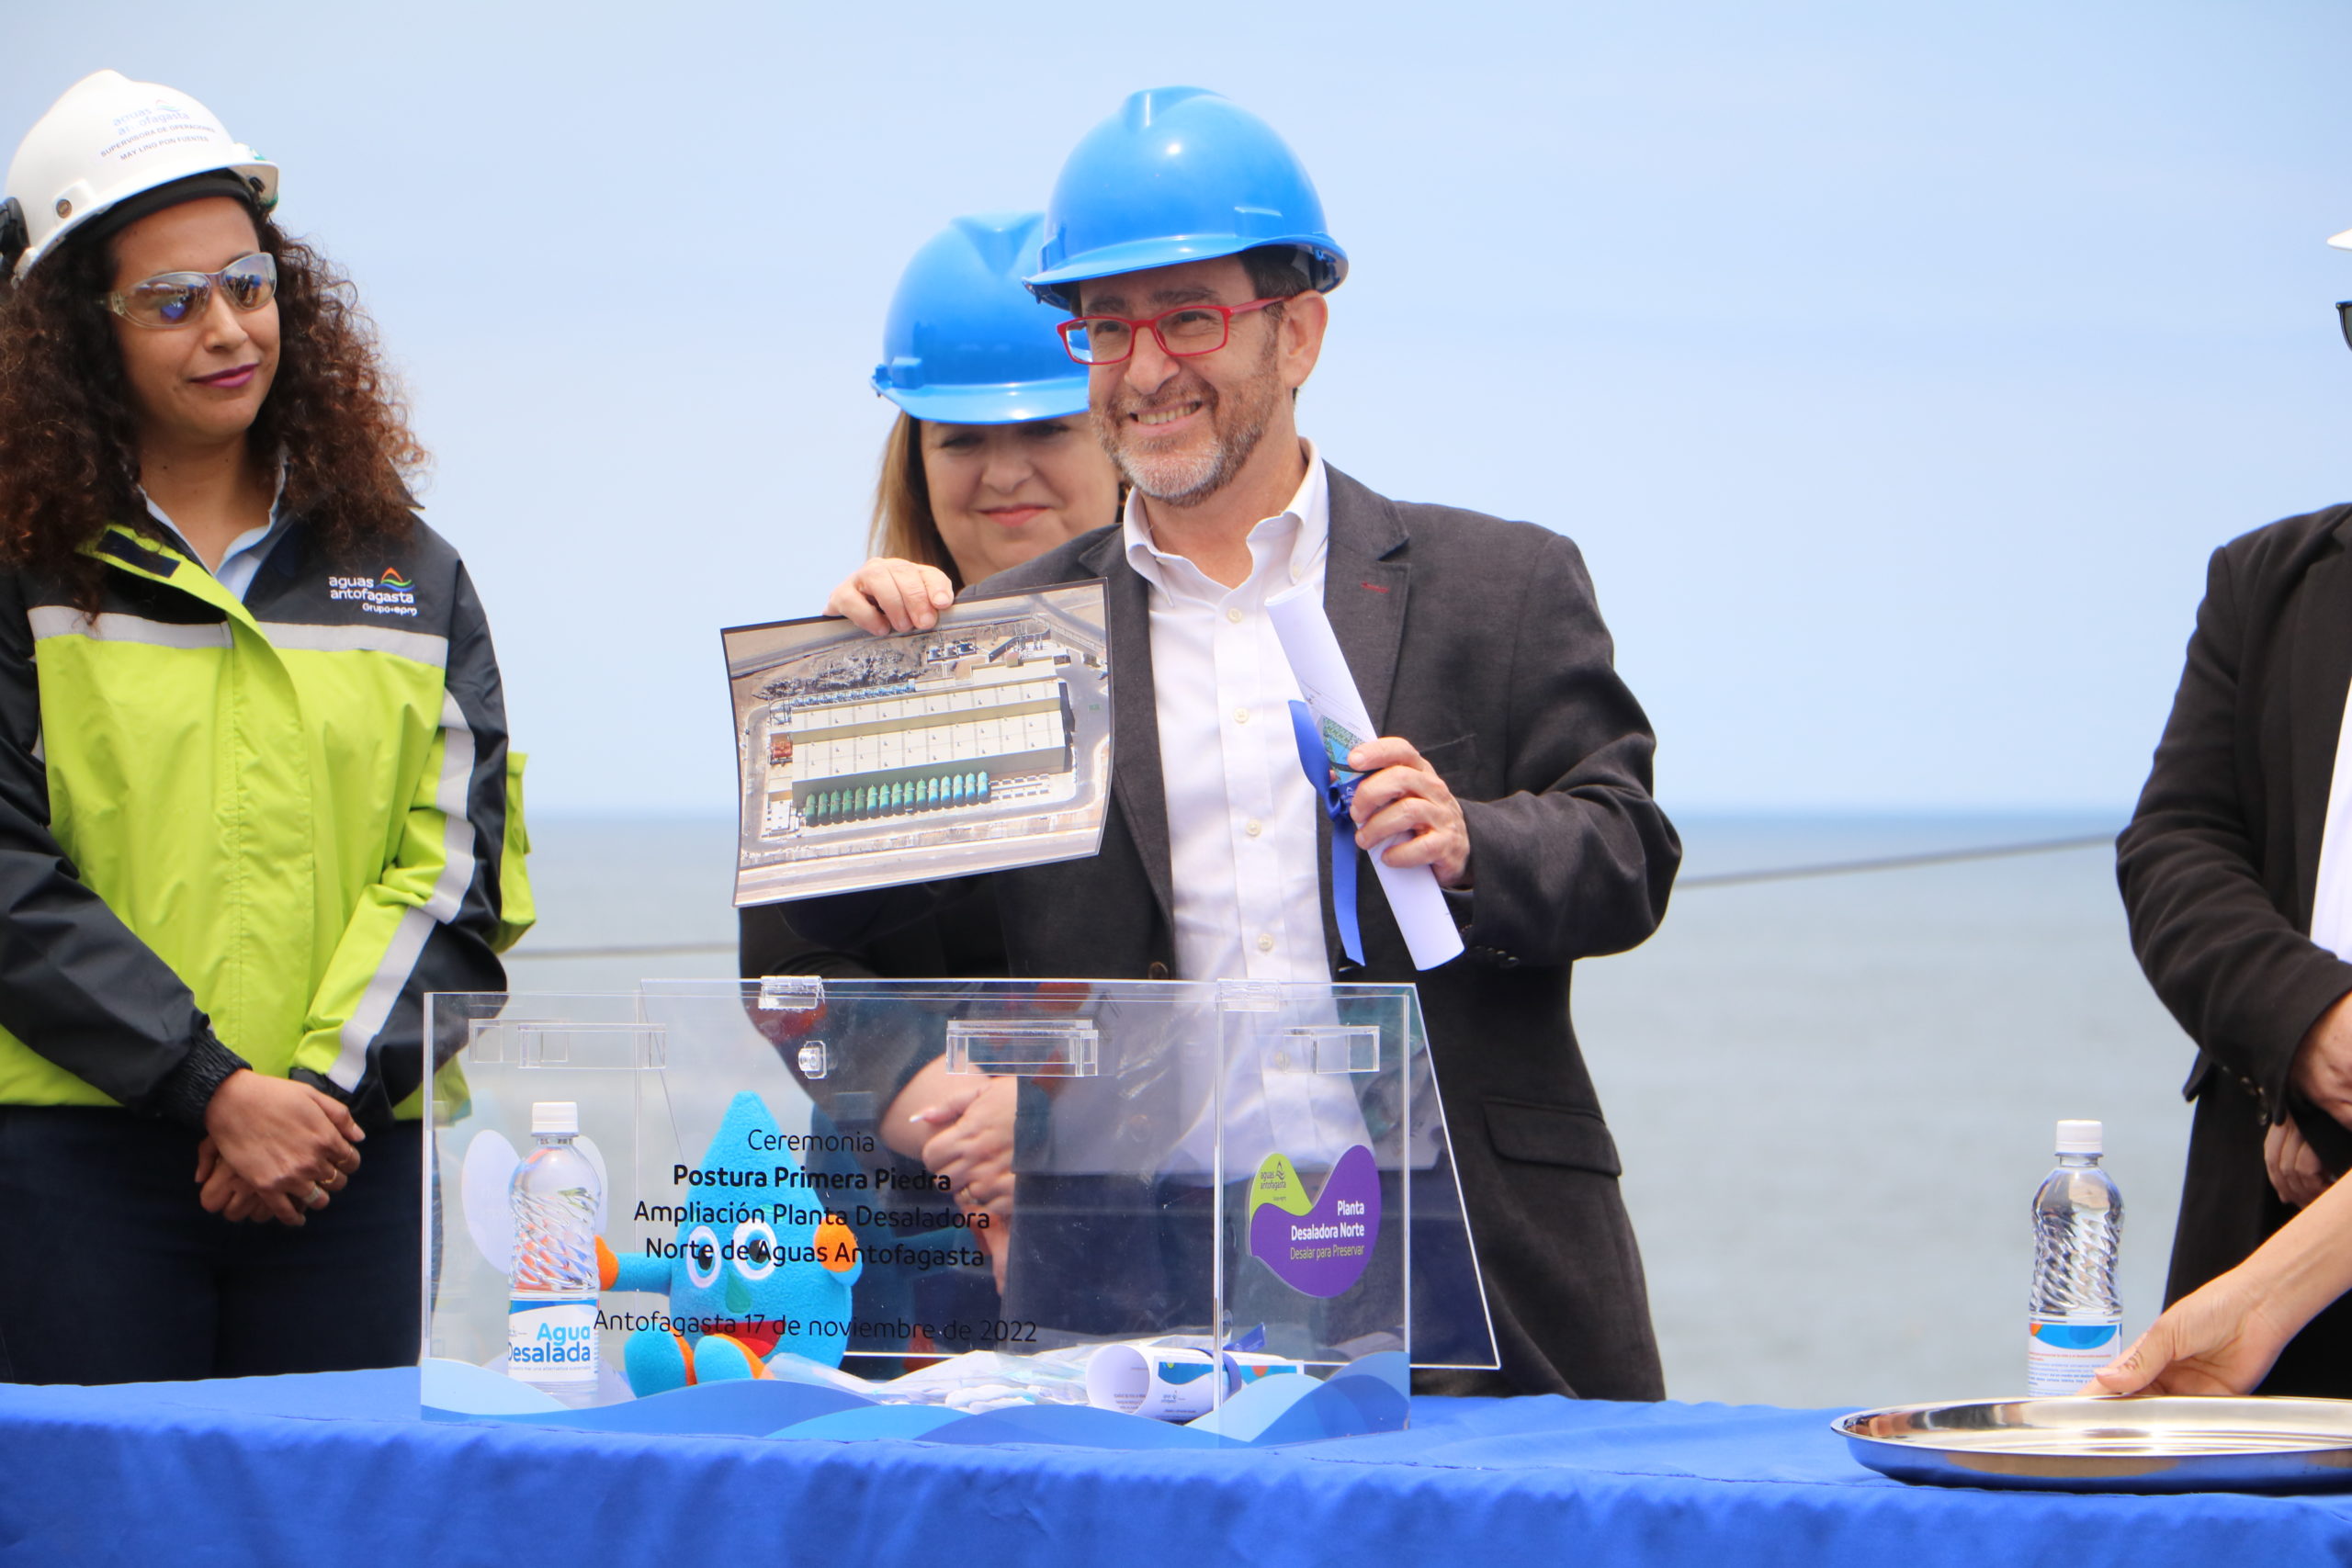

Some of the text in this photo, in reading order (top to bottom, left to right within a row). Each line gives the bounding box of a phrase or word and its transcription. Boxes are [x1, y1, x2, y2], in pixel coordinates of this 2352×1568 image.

[118, 112, 190, 136] anofagasta
[100, 130, 156, 158] SUPERVISORA
[119, 149, 136, 161] MAY
[329, 576, 374, 589] aguas
[330, 588, 414, 604] antofagasta
[748, 1130, 875, 1153] Ceremonia
[673, 1165, 951, 1191] Postura Primera Piedra
[1261, 1171, 1274, 1181] aguas
[1261, 1179, 1286, 1190] antofagasta
[634, 1201, 989, 1228] Ampliación Planta Desaladora
[1338, 1201, 1364, 1216] Planta
[1292, 1222, 1364, 1240] Desaladora Norte
[646, 1238, 984, 1270] Norte de Aguas Antofagasta
[1290, 1244, 1365, 1260] Desalar para Preservar
[537, 1323, 590, 1346] Agua
[594, 1311, 1037, 1342] Antofagasta 17 de noviembre de 2022
